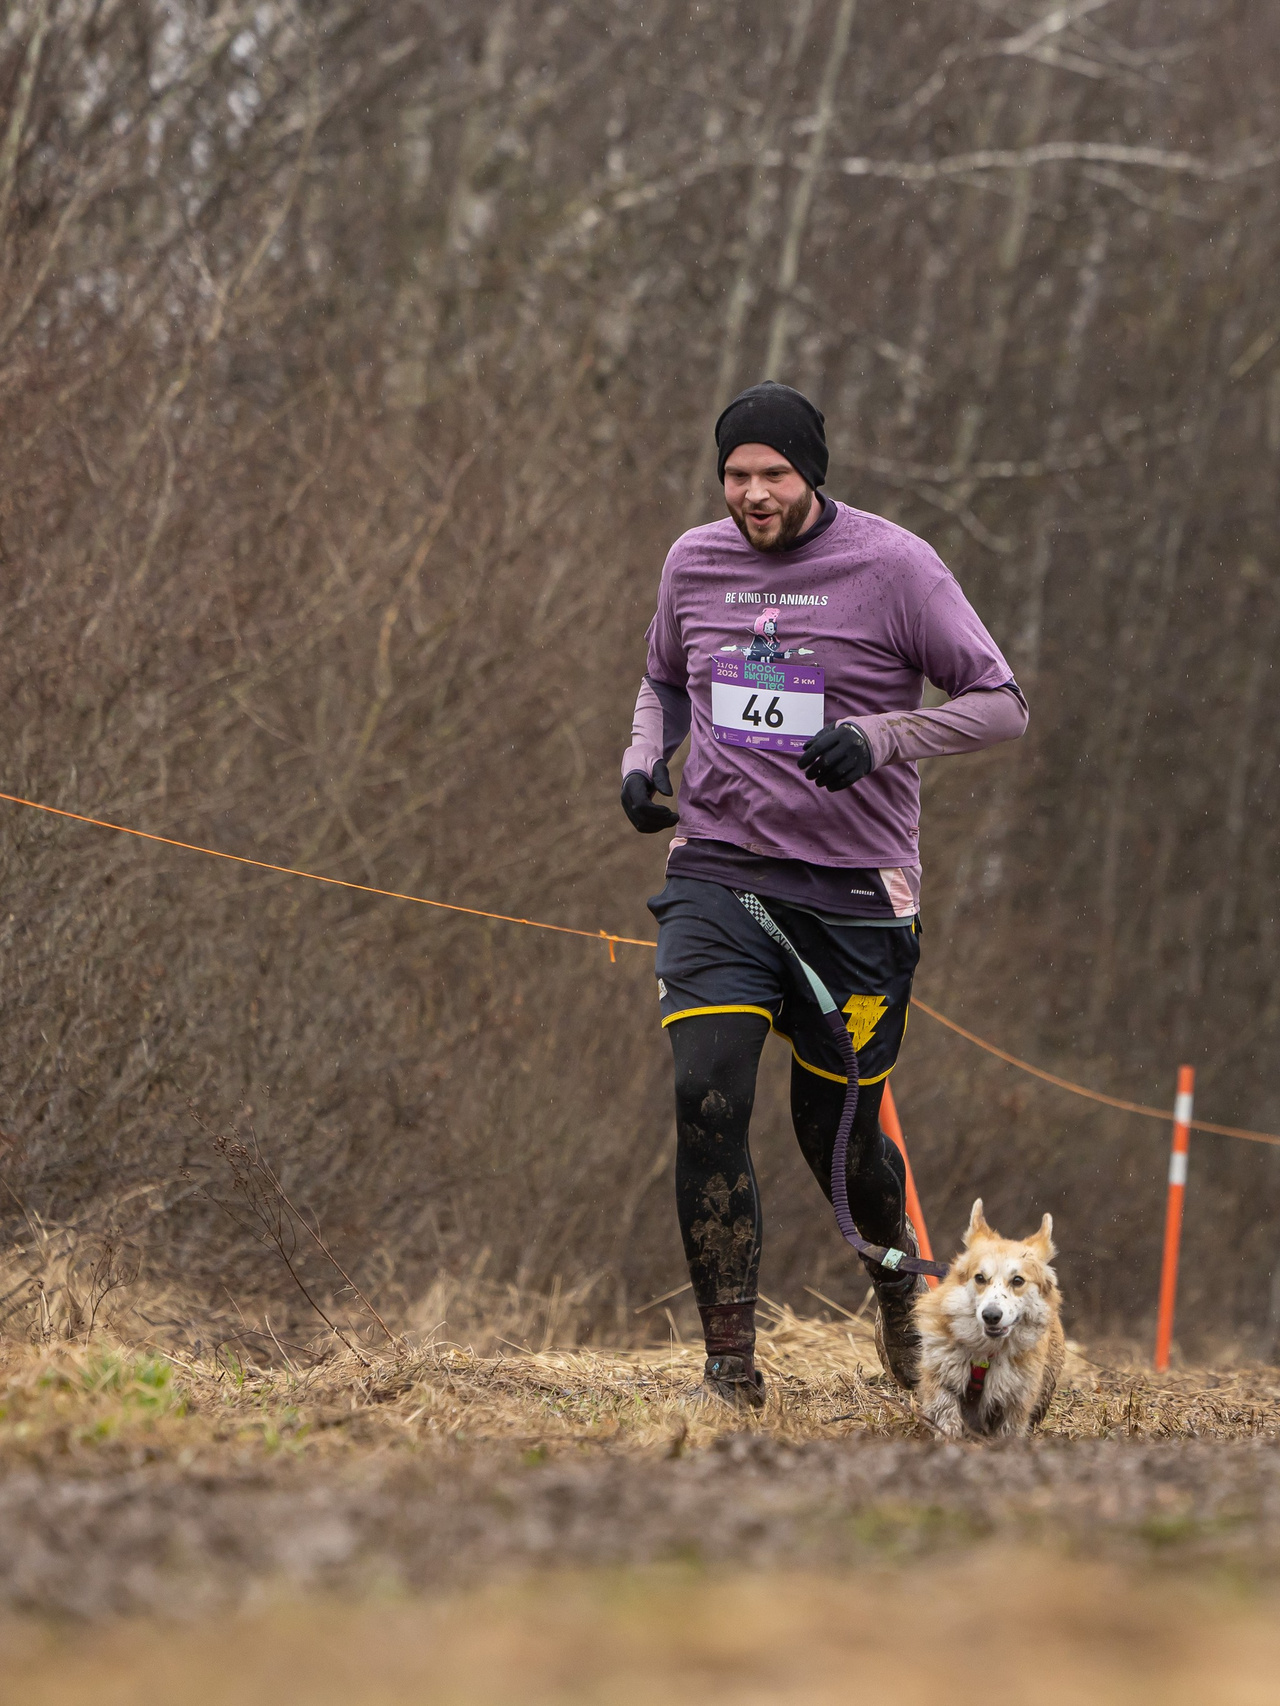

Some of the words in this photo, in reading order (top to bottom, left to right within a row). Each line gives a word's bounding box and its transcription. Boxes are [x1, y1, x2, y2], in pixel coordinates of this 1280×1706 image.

[725, 592, 736, 603] BE
[738, 592, 761, 604] KIND
[763, 593, 777, 604] TO
[779, 594, 828, 606] ANIMALS
[717, 662, 738, 671] 11/04
[717, 669, 738, 679] 2026
[744, 671, 785, 683] БЫСТРЫЙ
[742, 694, 783, 728] 46
